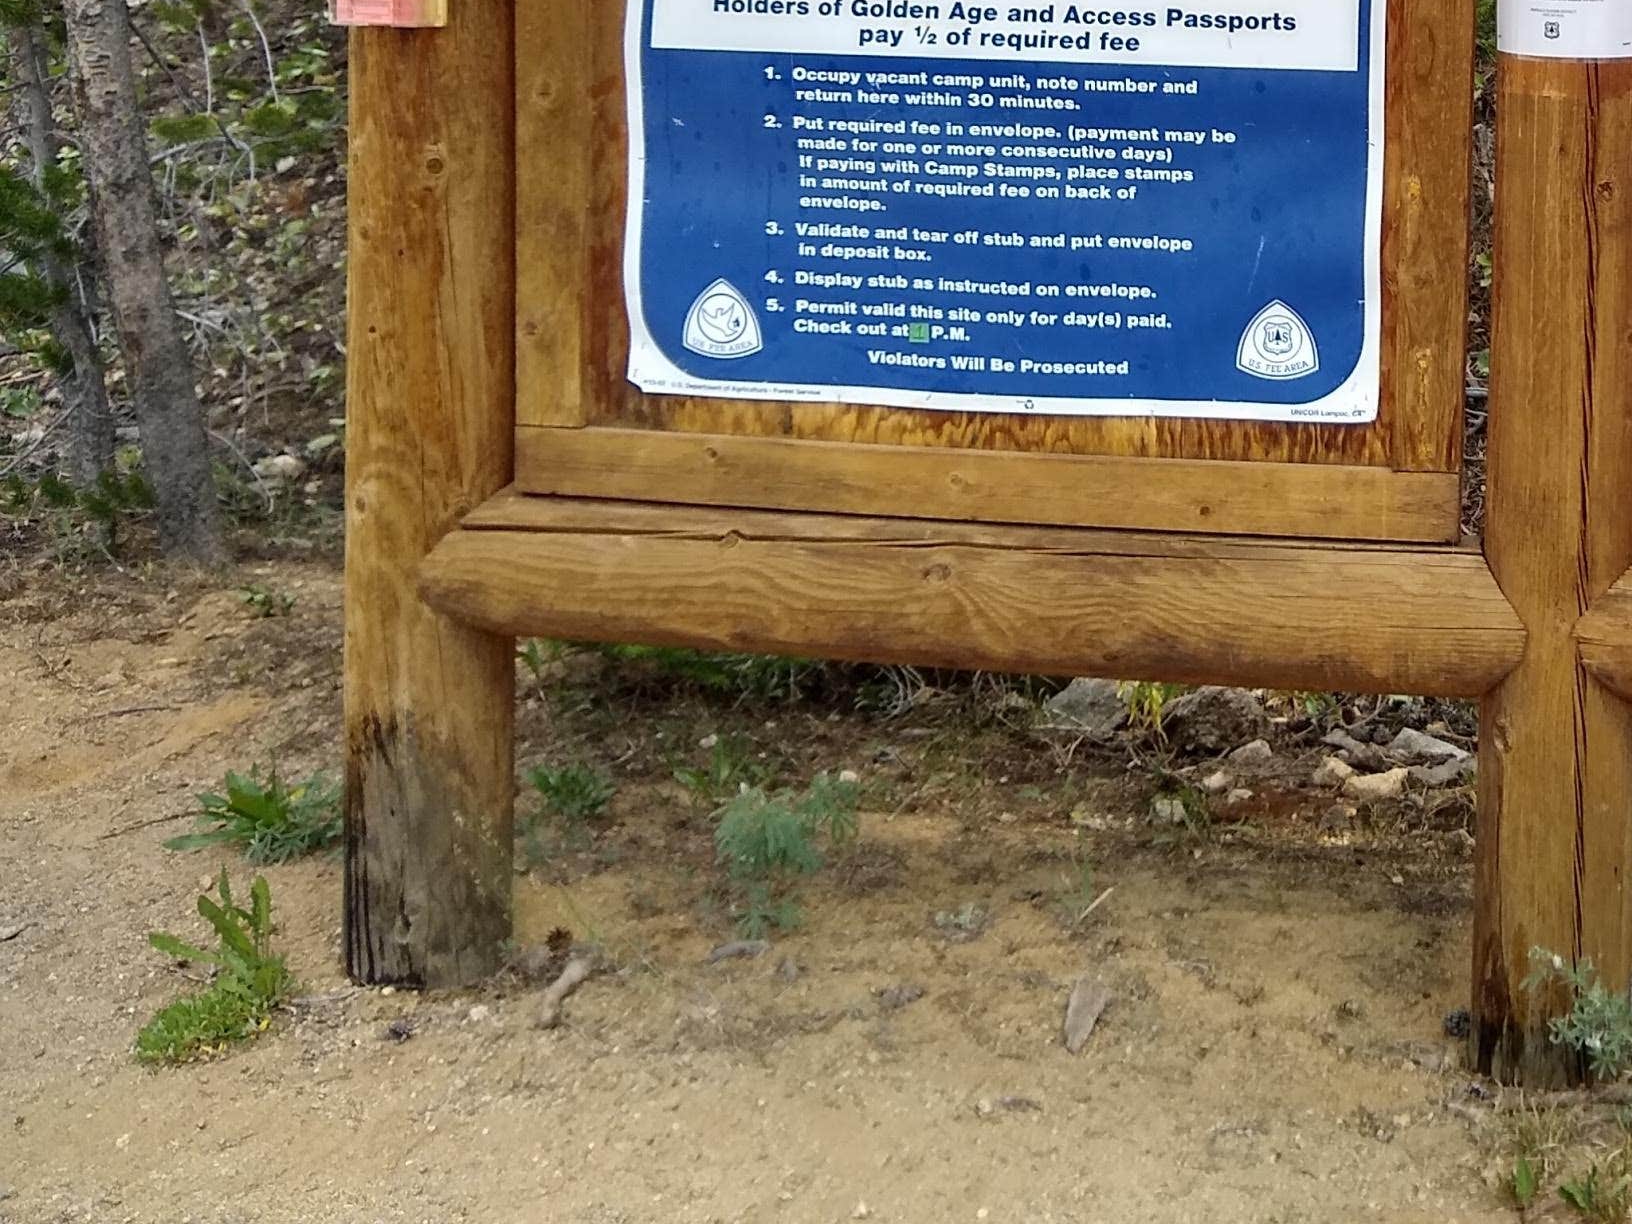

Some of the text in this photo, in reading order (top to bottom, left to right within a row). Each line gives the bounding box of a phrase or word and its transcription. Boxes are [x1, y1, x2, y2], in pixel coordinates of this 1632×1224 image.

[852, 0, 938, 19] Golden
[949, 2, 997, 24] Age
[1008, 5, 1053, 22] and
[1064, 6, 1156, 26] Access
[1167, 9, 1296, 32] Passports
[859, 29, 903, 47] pay
[947, 28, 971, 45] of
[981, 30, 1090, 51] required
[1100, 32, 1139, 51] fee
[764, 67, 1197, 94] 1. Occupy vacant camp unit, note number and
[796, 89, 1080, 109] return here within 30 minutes.
[800, 196, 886, 211] envelope.
[765, 271, 1156, 299] 4. Display stub as instructed on envelope.
[766, 299, 1171, 328] 5. Permit valid this site only for day(s) paid.
[794, 319, 851, 334] Check
[857, 323, 887, 335] out
[892, 324, 909, 336] at
[932, 326, 970, 341] P.M.
[868, 351, 1128, 374] Violators Will Be Prosecuted
[1266, 364, 1282, 372] FEE
[1284, 361, 1308, 372] AREA
